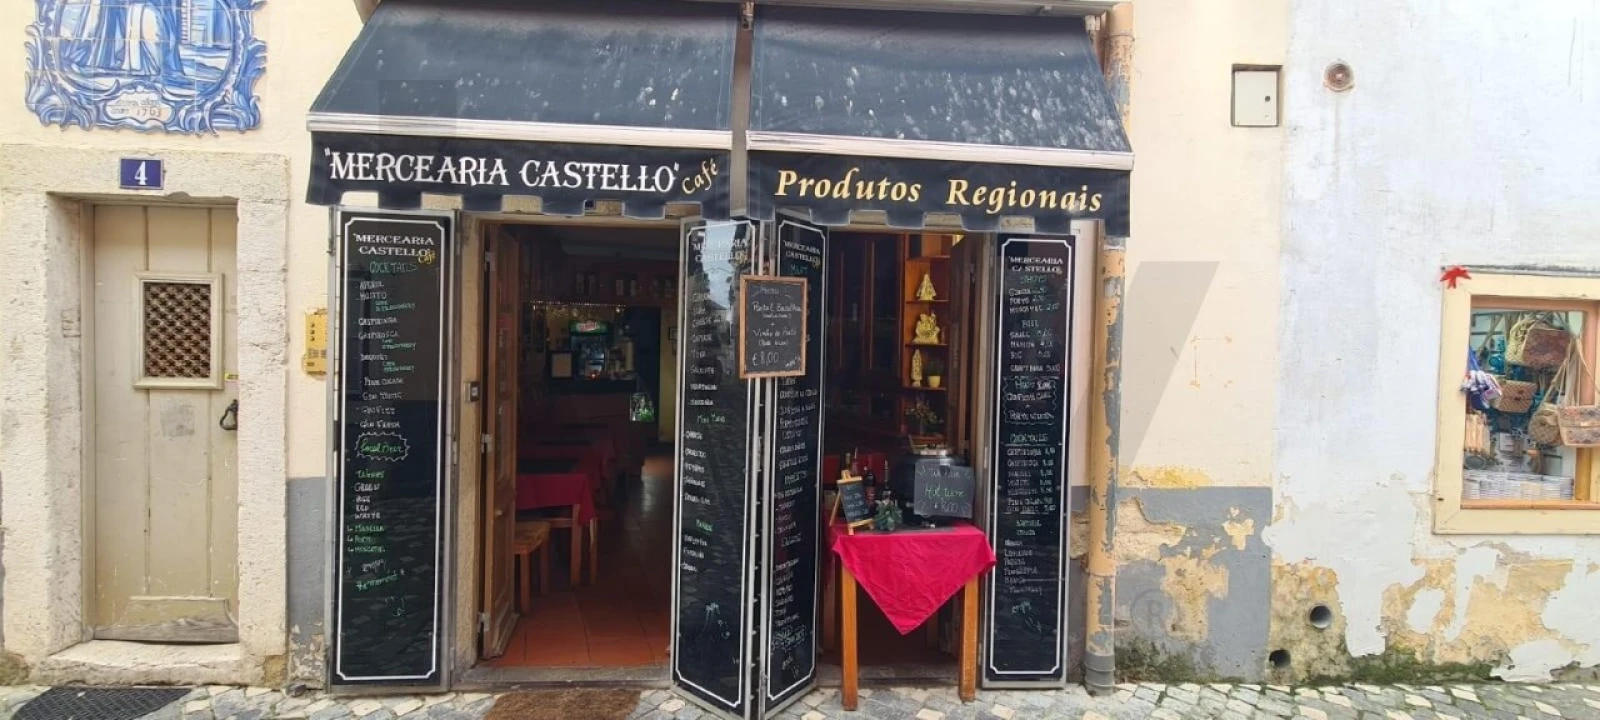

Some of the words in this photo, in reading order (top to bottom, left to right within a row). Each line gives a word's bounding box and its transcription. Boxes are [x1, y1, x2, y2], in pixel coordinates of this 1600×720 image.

[134, 161, 148, 185] 4
[682, 158, 718, 195] Café
[774, 166, 922, 203] Produtos
[946, 178, 1103, 215] Regionais
